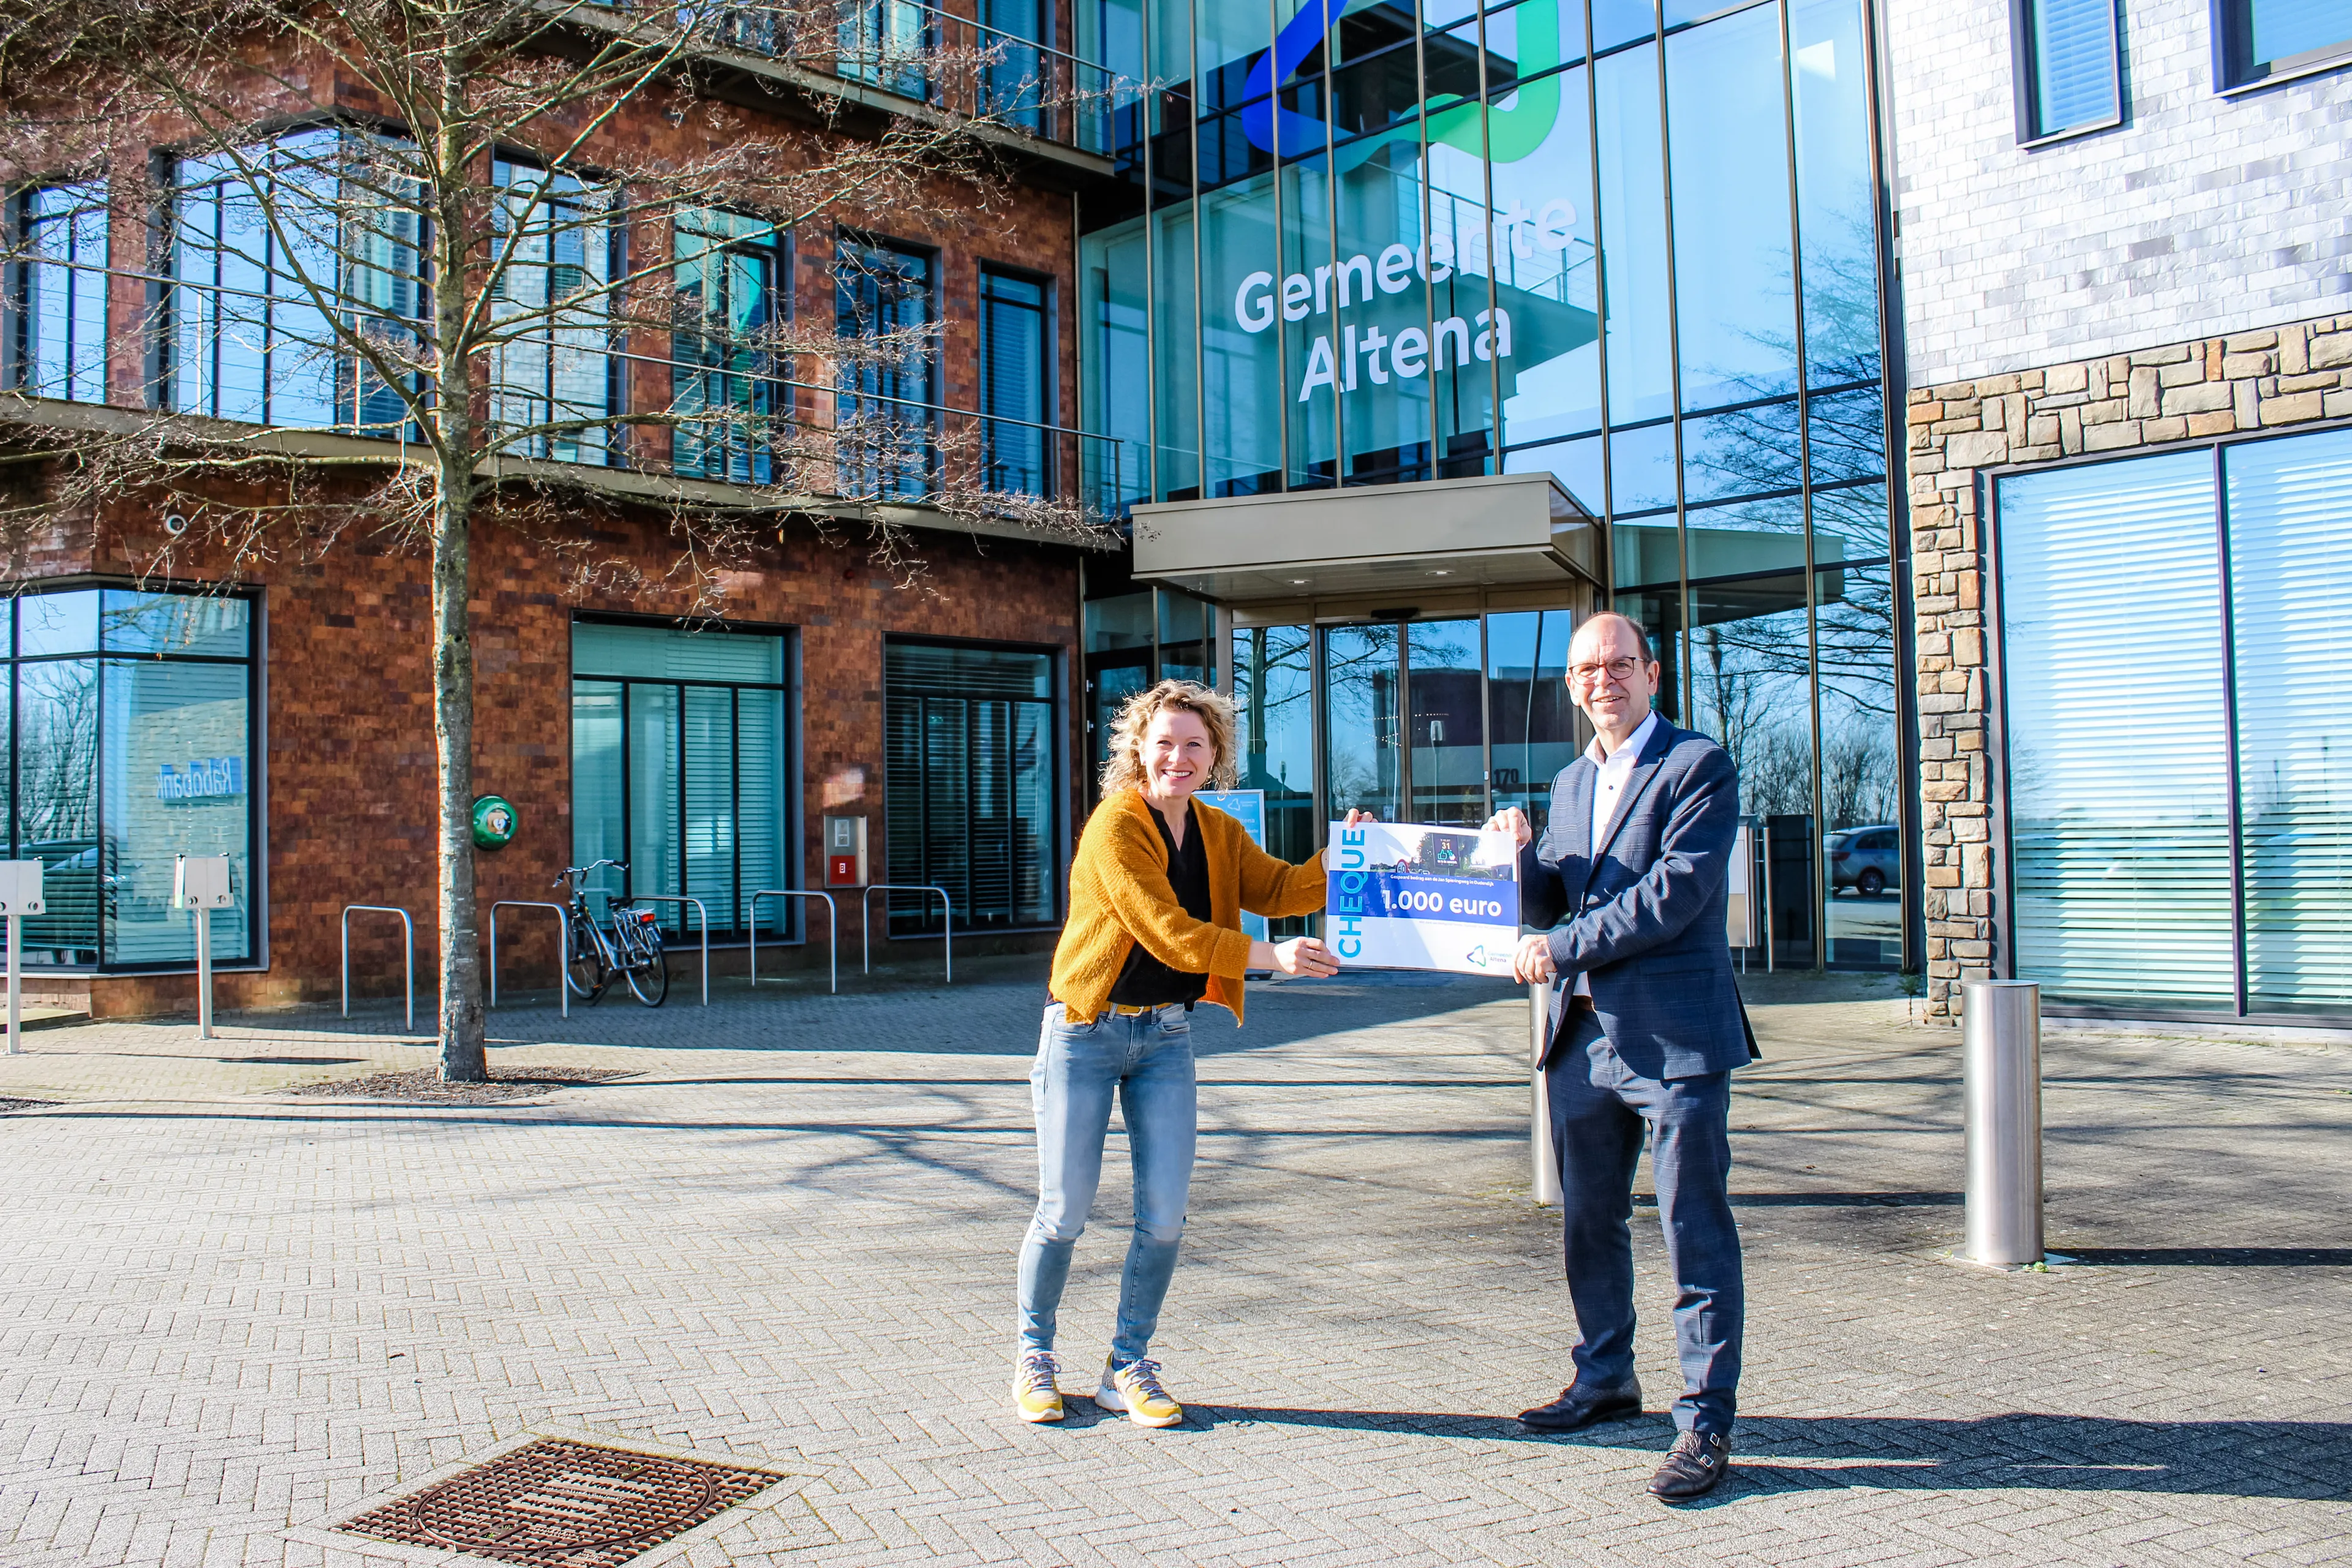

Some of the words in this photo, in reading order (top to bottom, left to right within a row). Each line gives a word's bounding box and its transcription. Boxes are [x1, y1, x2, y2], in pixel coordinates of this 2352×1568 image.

[1235, 198, 1577, 333] Gemeente
[1298, 307, 1512, 402] Altena
[1494, 768, 1518, 785] 170
[1338, 829, 1368, 958] CHEQUE
[1382, 890, 1443, 913] 1.000
[1449, 897, 1502, 917] euro
